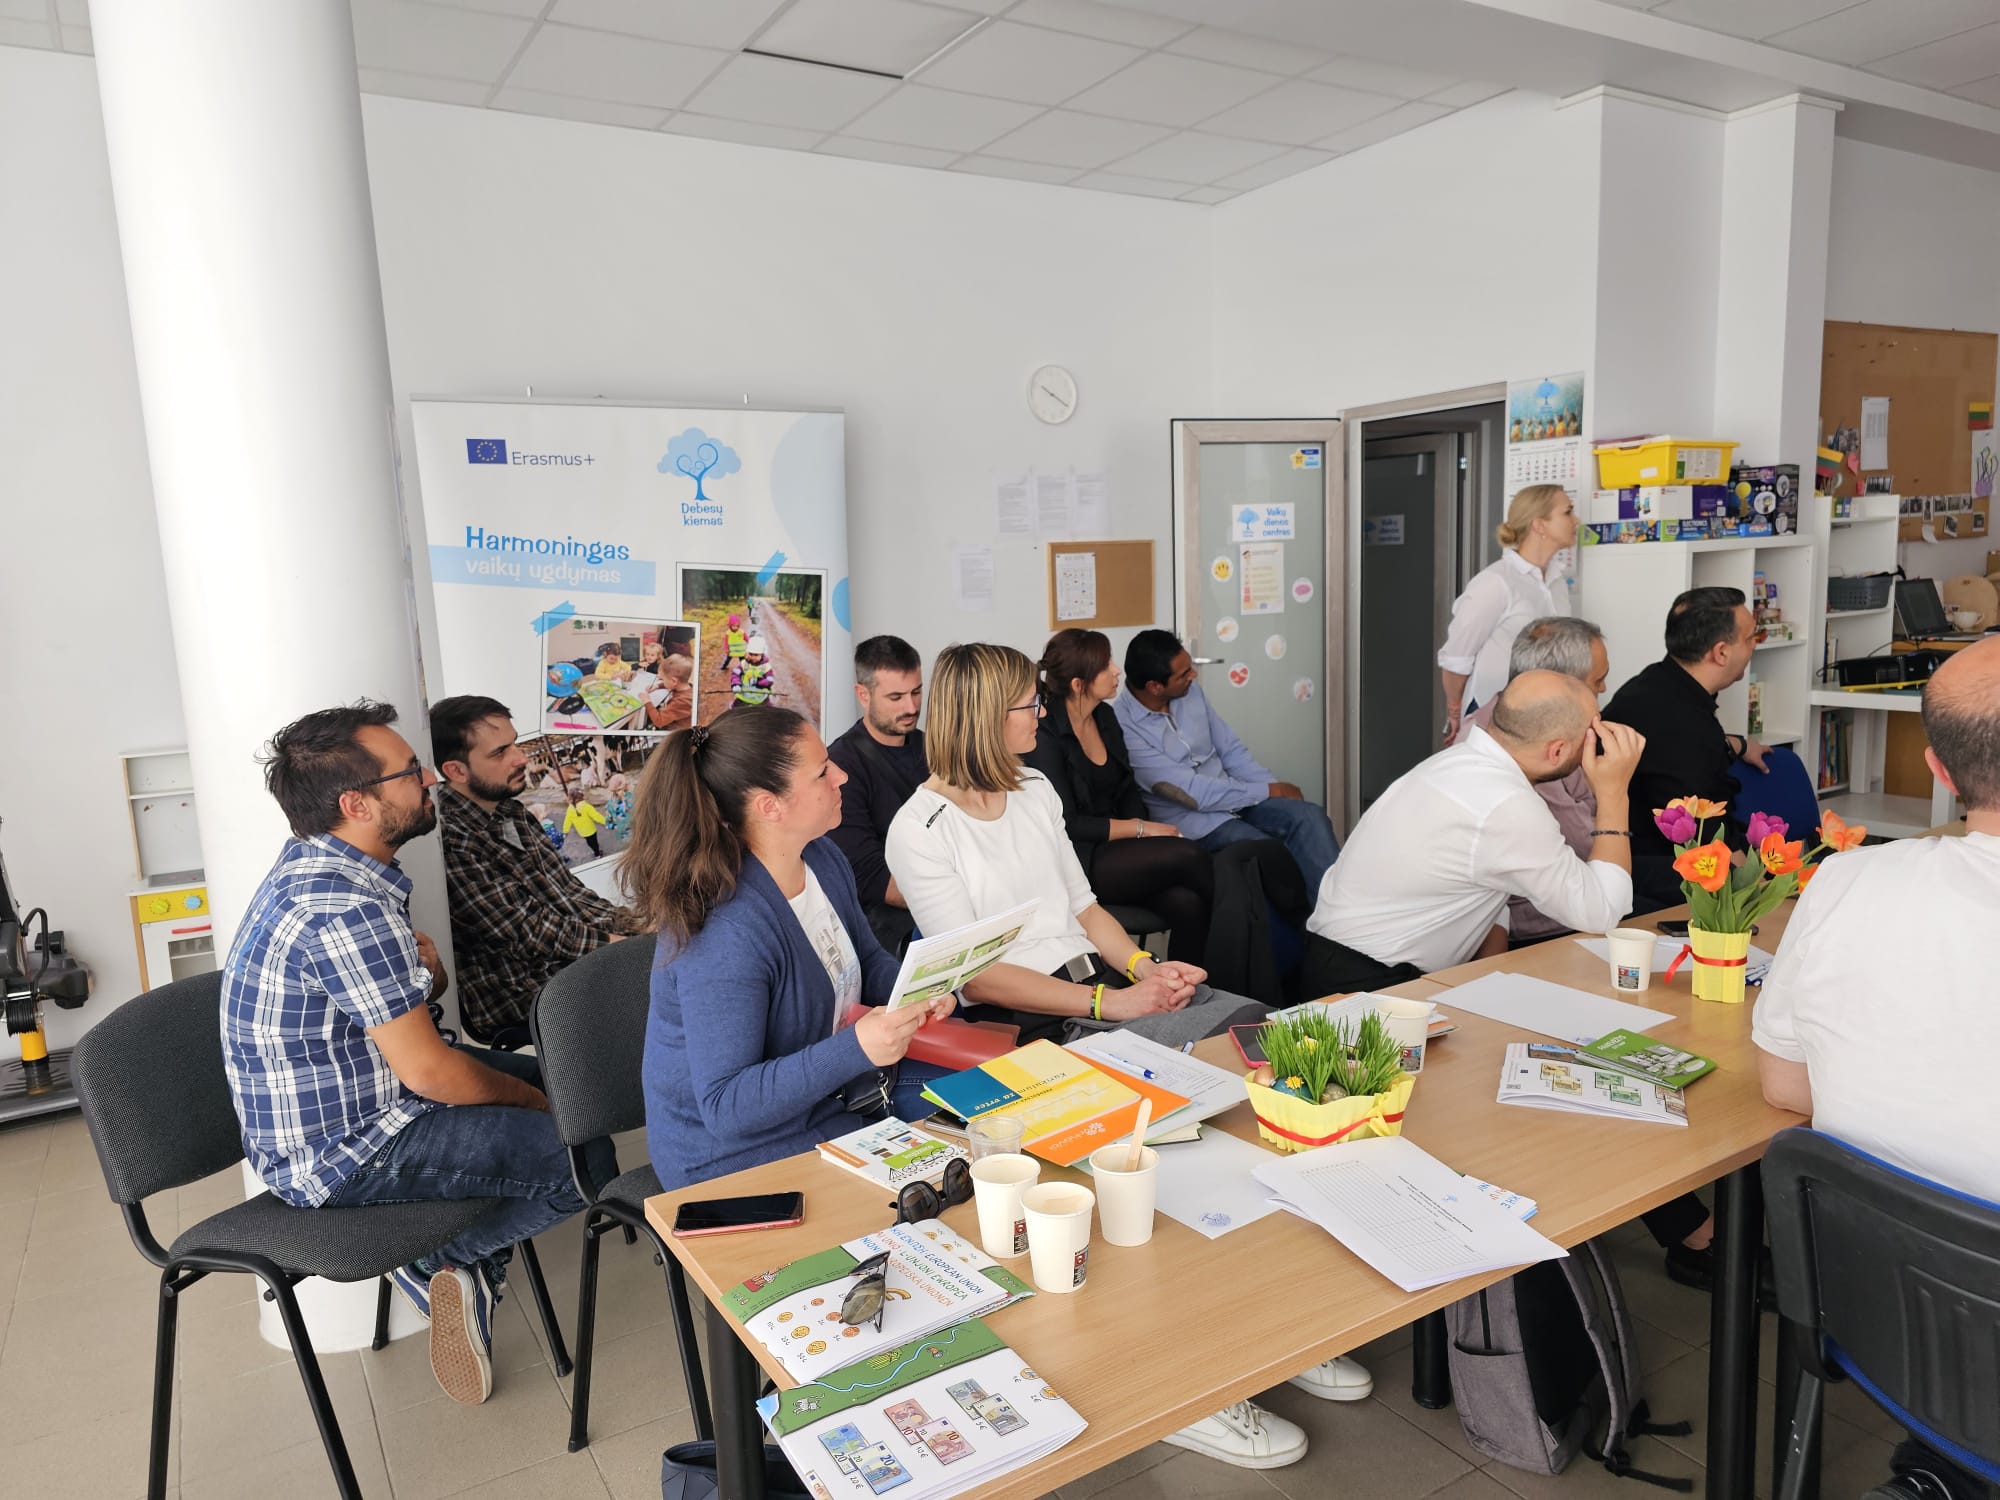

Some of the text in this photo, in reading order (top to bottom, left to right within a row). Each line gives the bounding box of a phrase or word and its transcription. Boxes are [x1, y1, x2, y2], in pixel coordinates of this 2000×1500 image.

[511, 451, 596, 466] Erasmus+
[683, 514, 724, 526] kiemas
[465, 525, 630, 565] Harmoningas
[465, 556, 622, 586] vaikų ugdymas
[924, 1253, 985, 1295] EUROPEAN UNION
[930, 1274, 968, 1301] EWROPEA
[999, 1405, 1011, 1414] 5
[901, 1425, 914, 1437] 10
[945, 1430, 960, 1442] 10
[833, 1450, 848, 1464] 20
[879, 1453, 897, 1468] 20
